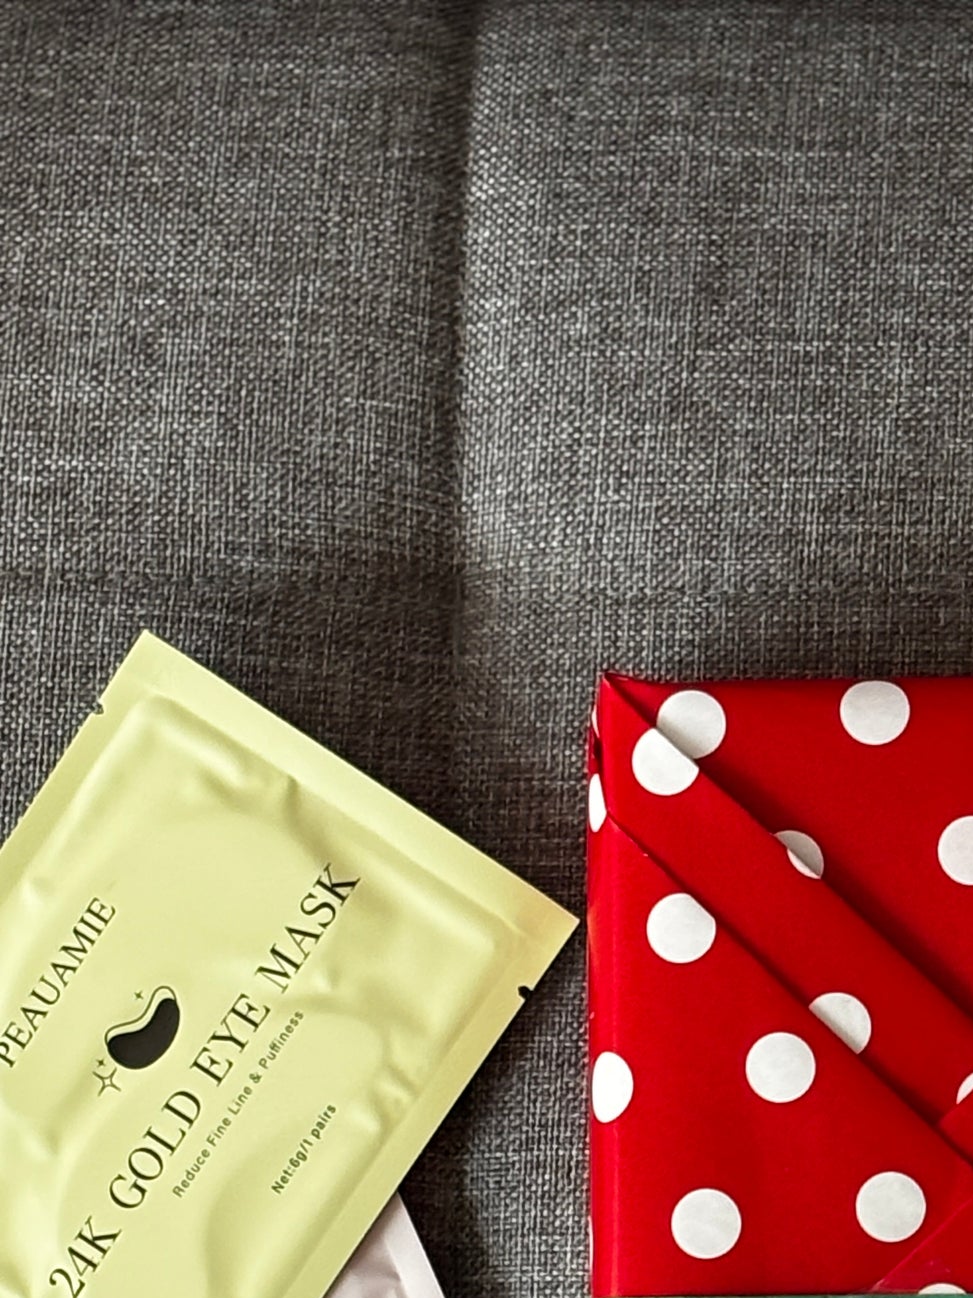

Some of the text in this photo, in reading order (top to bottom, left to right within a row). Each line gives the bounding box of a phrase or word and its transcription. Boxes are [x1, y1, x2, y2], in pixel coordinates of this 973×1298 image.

[0, 896, 117, 1068] PEAUAMIE
[108, 1089, 202, 1210] GOLD
[189, 992, 271, 1088] EYE
[255, 862, 361, 994] MASK
[172, 1010, 304, 1198] Reduce Fine Line & Puffiness
[311, 1104, 336, 1140] pairs
